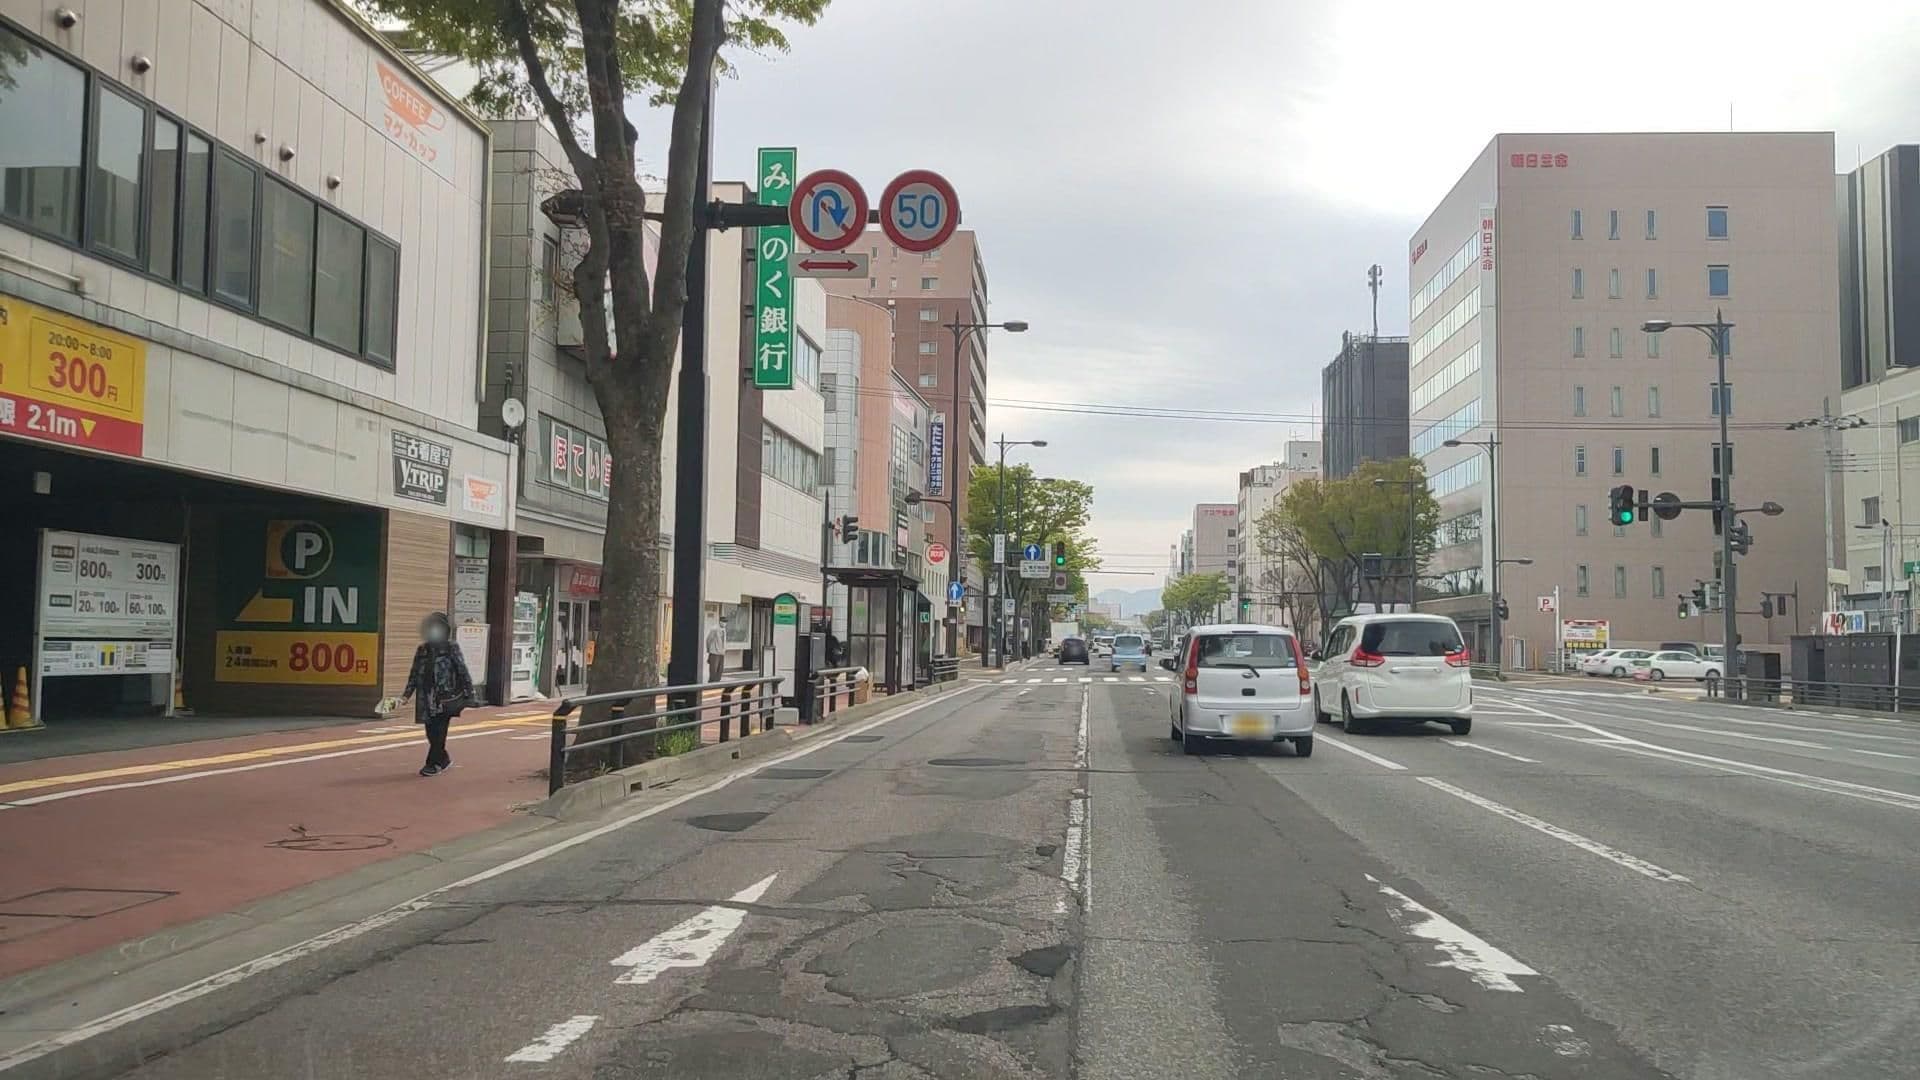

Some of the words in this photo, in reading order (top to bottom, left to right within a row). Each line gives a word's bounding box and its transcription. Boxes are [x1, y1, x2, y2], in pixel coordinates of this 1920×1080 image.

[383, 75, 426, 121] COFFEE
[898, 194, 941, 229] 50
[1482, 219, 1493, 271] 朝日生命
[759, 162, 790, 370] みのく銀行
[27, 404, 77, 437] 2.1m
[295, 532, 323, 568] P
[304, 586, 359, 624] IN
[289, 642, 368, 673] 800円
